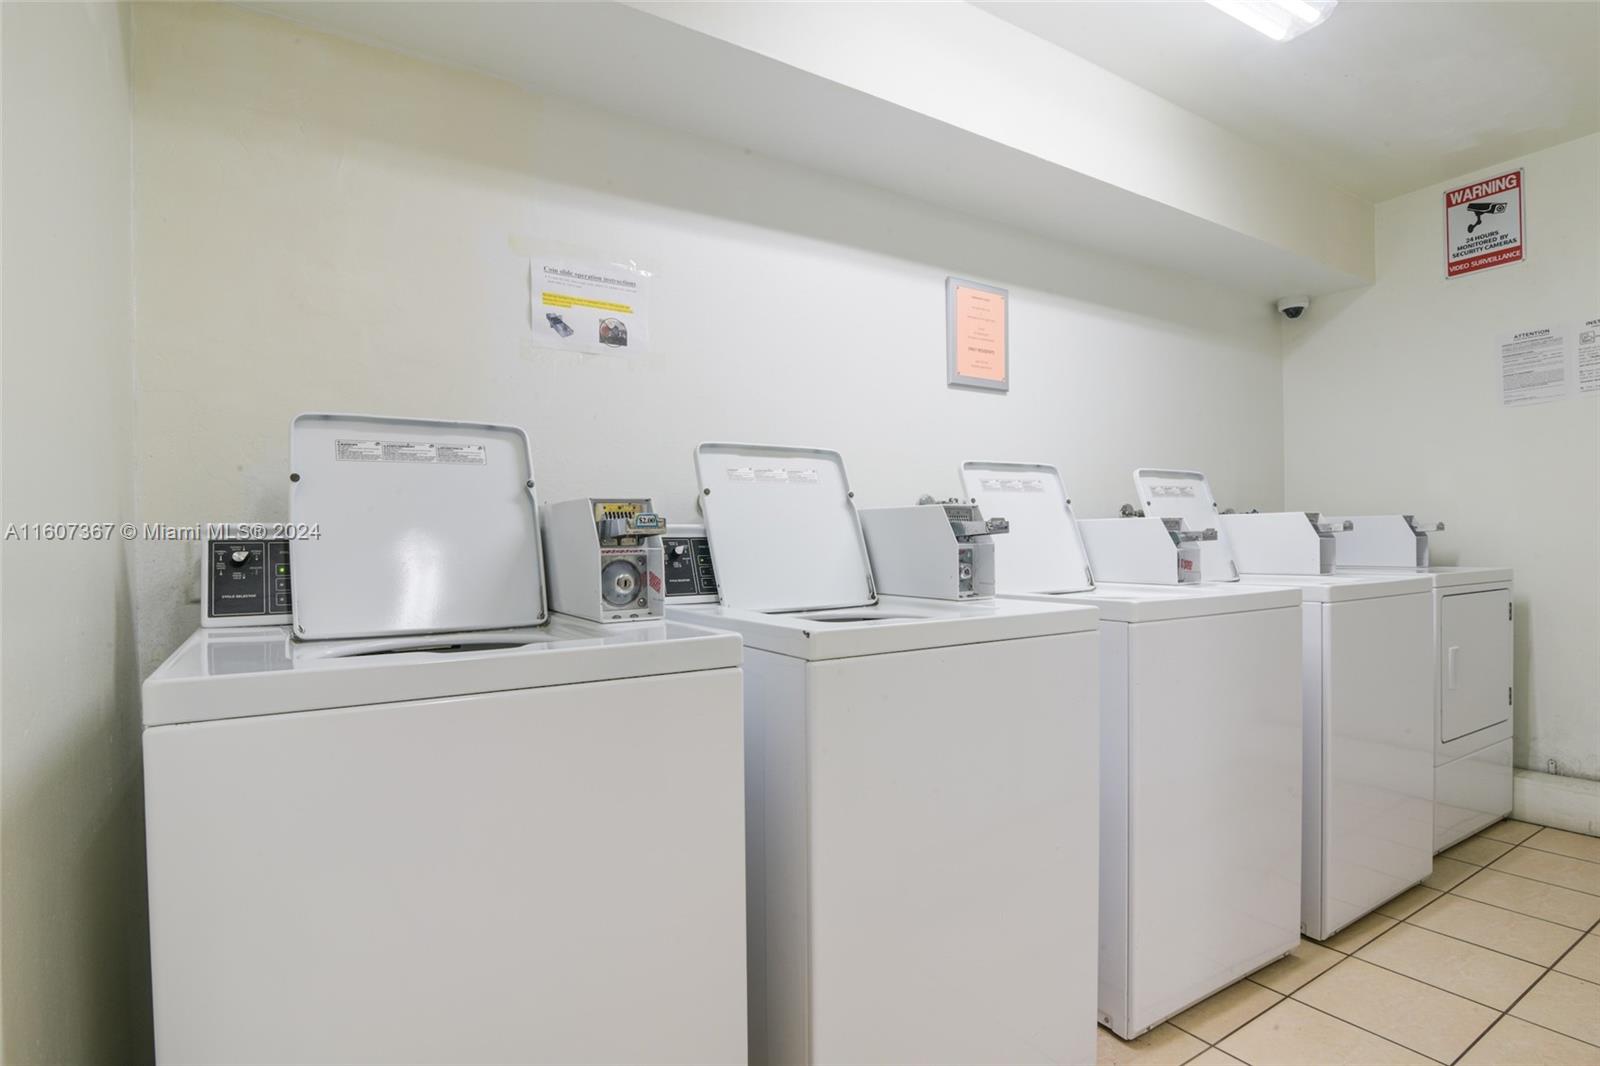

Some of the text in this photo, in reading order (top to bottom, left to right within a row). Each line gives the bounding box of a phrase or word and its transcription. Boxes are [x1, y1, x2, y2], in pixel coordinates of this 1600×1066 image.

[1450, 175, 1517, 204] WARNING
[1457, 233, 1509, 251] MONITORED BY
[1466, 230, 1499, 244] 24 HOURS
[1452, 238, 1517, 258] SECURITY CAMERAS
[1449, 251, 1520, 272] VIDEO SURVEILLANCE
[1514, 329, 1550, 339] ATTENTION
[638, 516, 656, 524] $2.00
